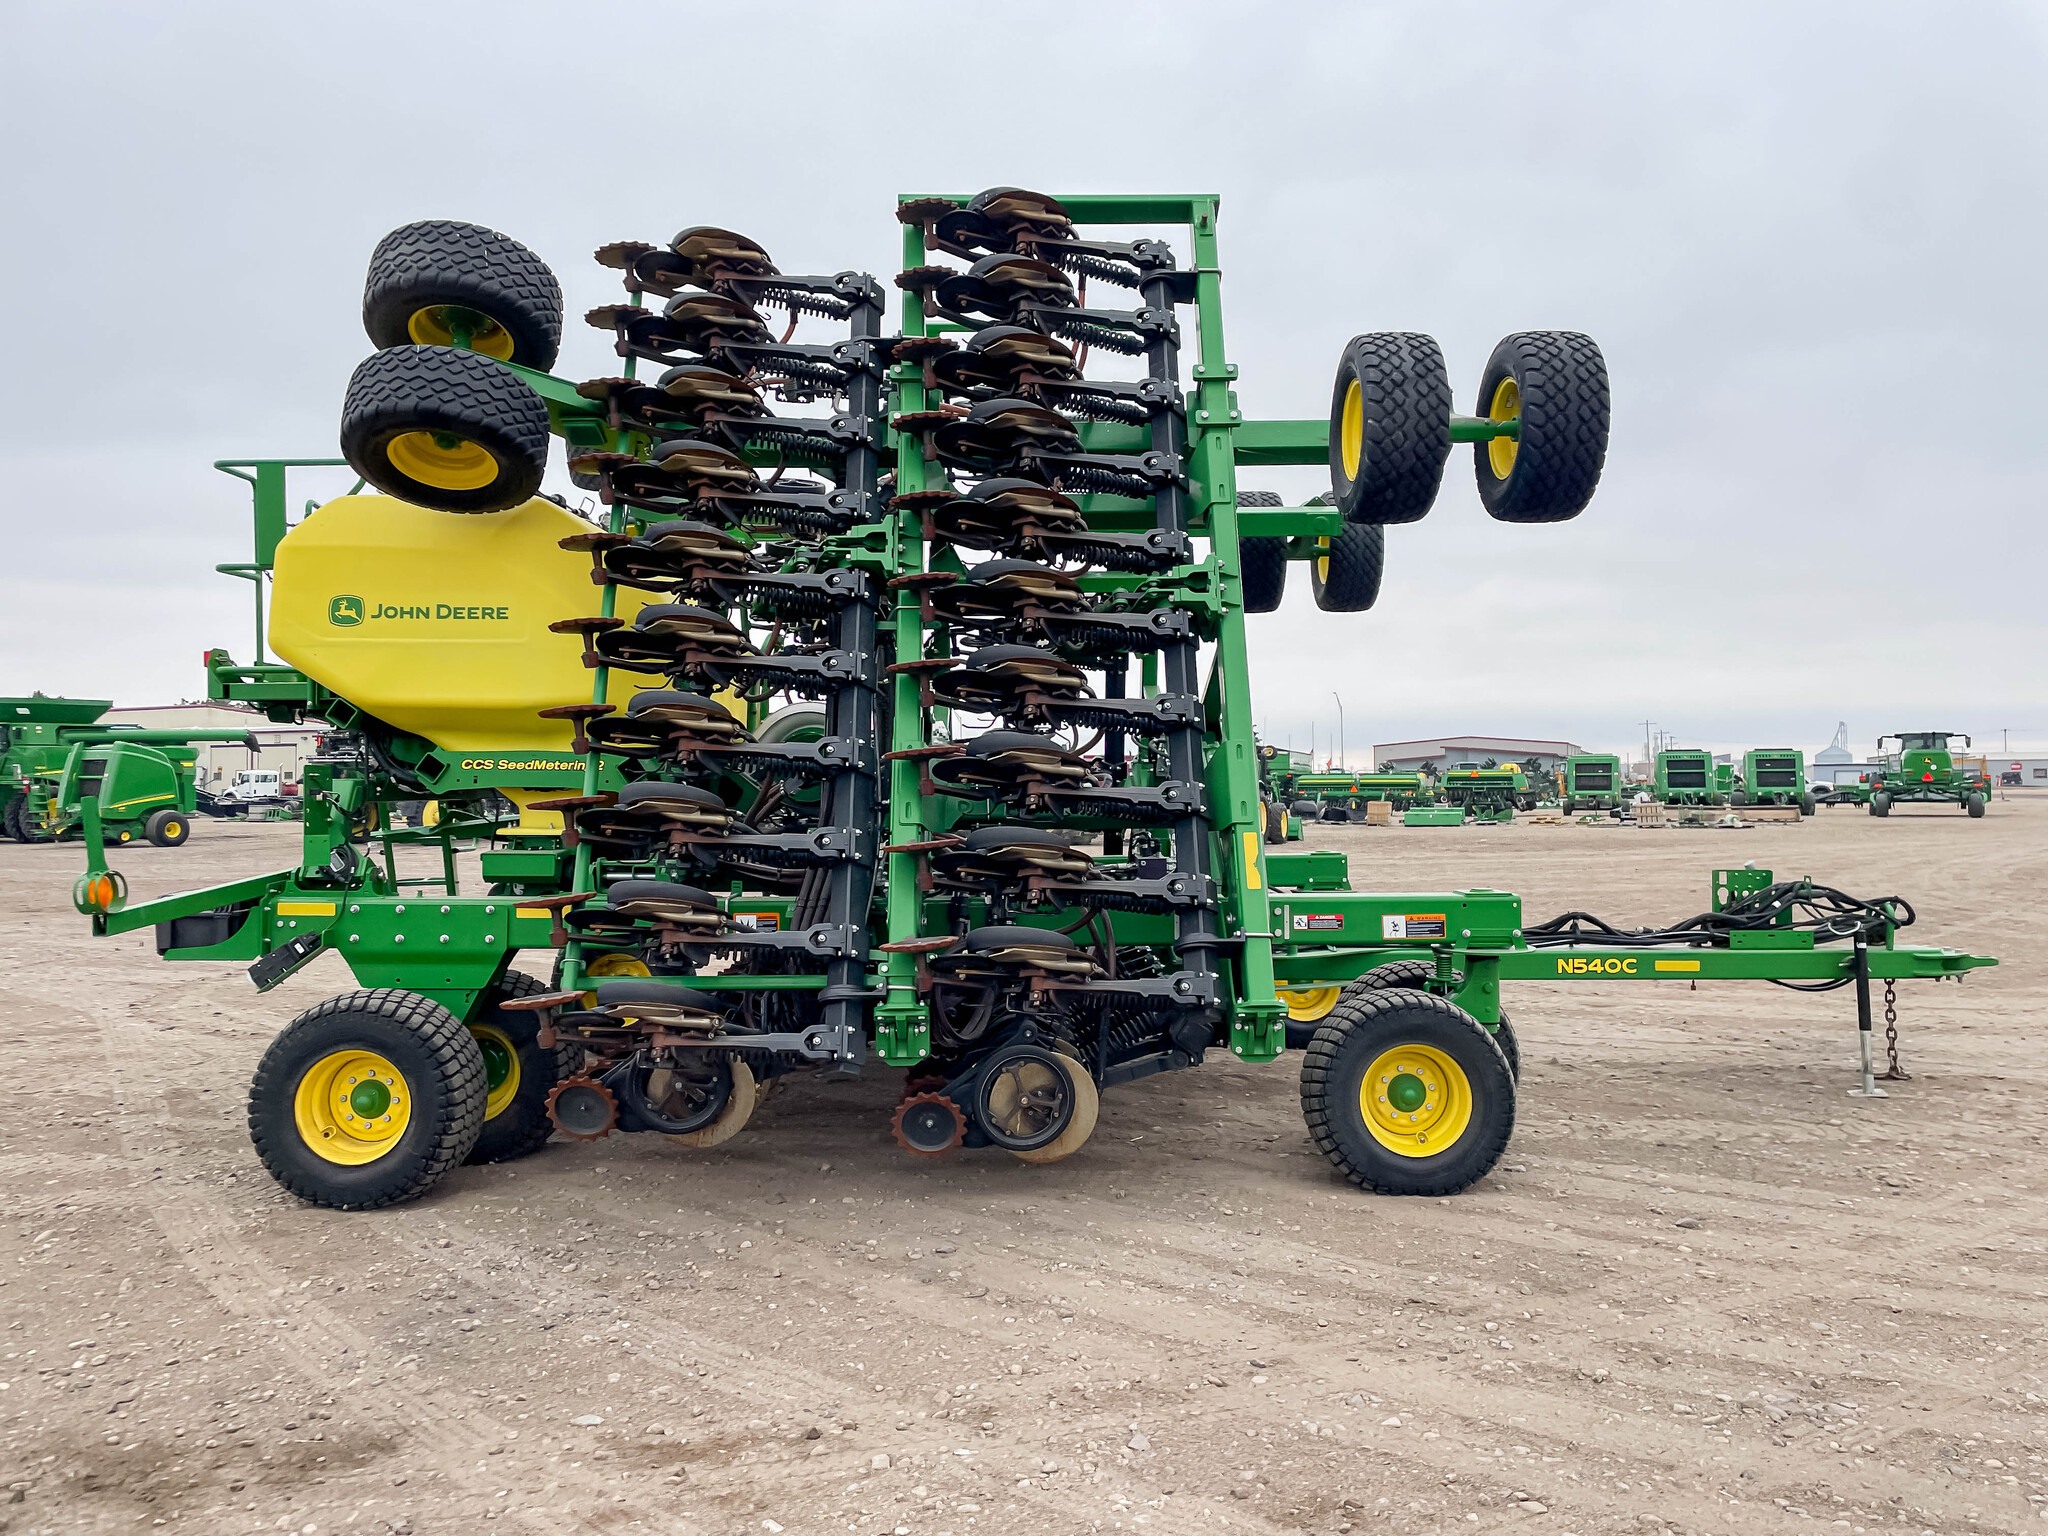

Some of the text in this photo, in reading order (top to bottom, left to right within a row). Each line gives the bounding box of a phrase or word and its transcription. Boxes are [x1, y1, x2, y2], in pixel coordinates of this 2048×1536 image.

[371, 603, 509, 620] JOHN DEERE
[461, 759, 495, 770] CCS
[497, 759, 588, 772] SeedMeterin
[1557, 958, 1638, 974] N540C
